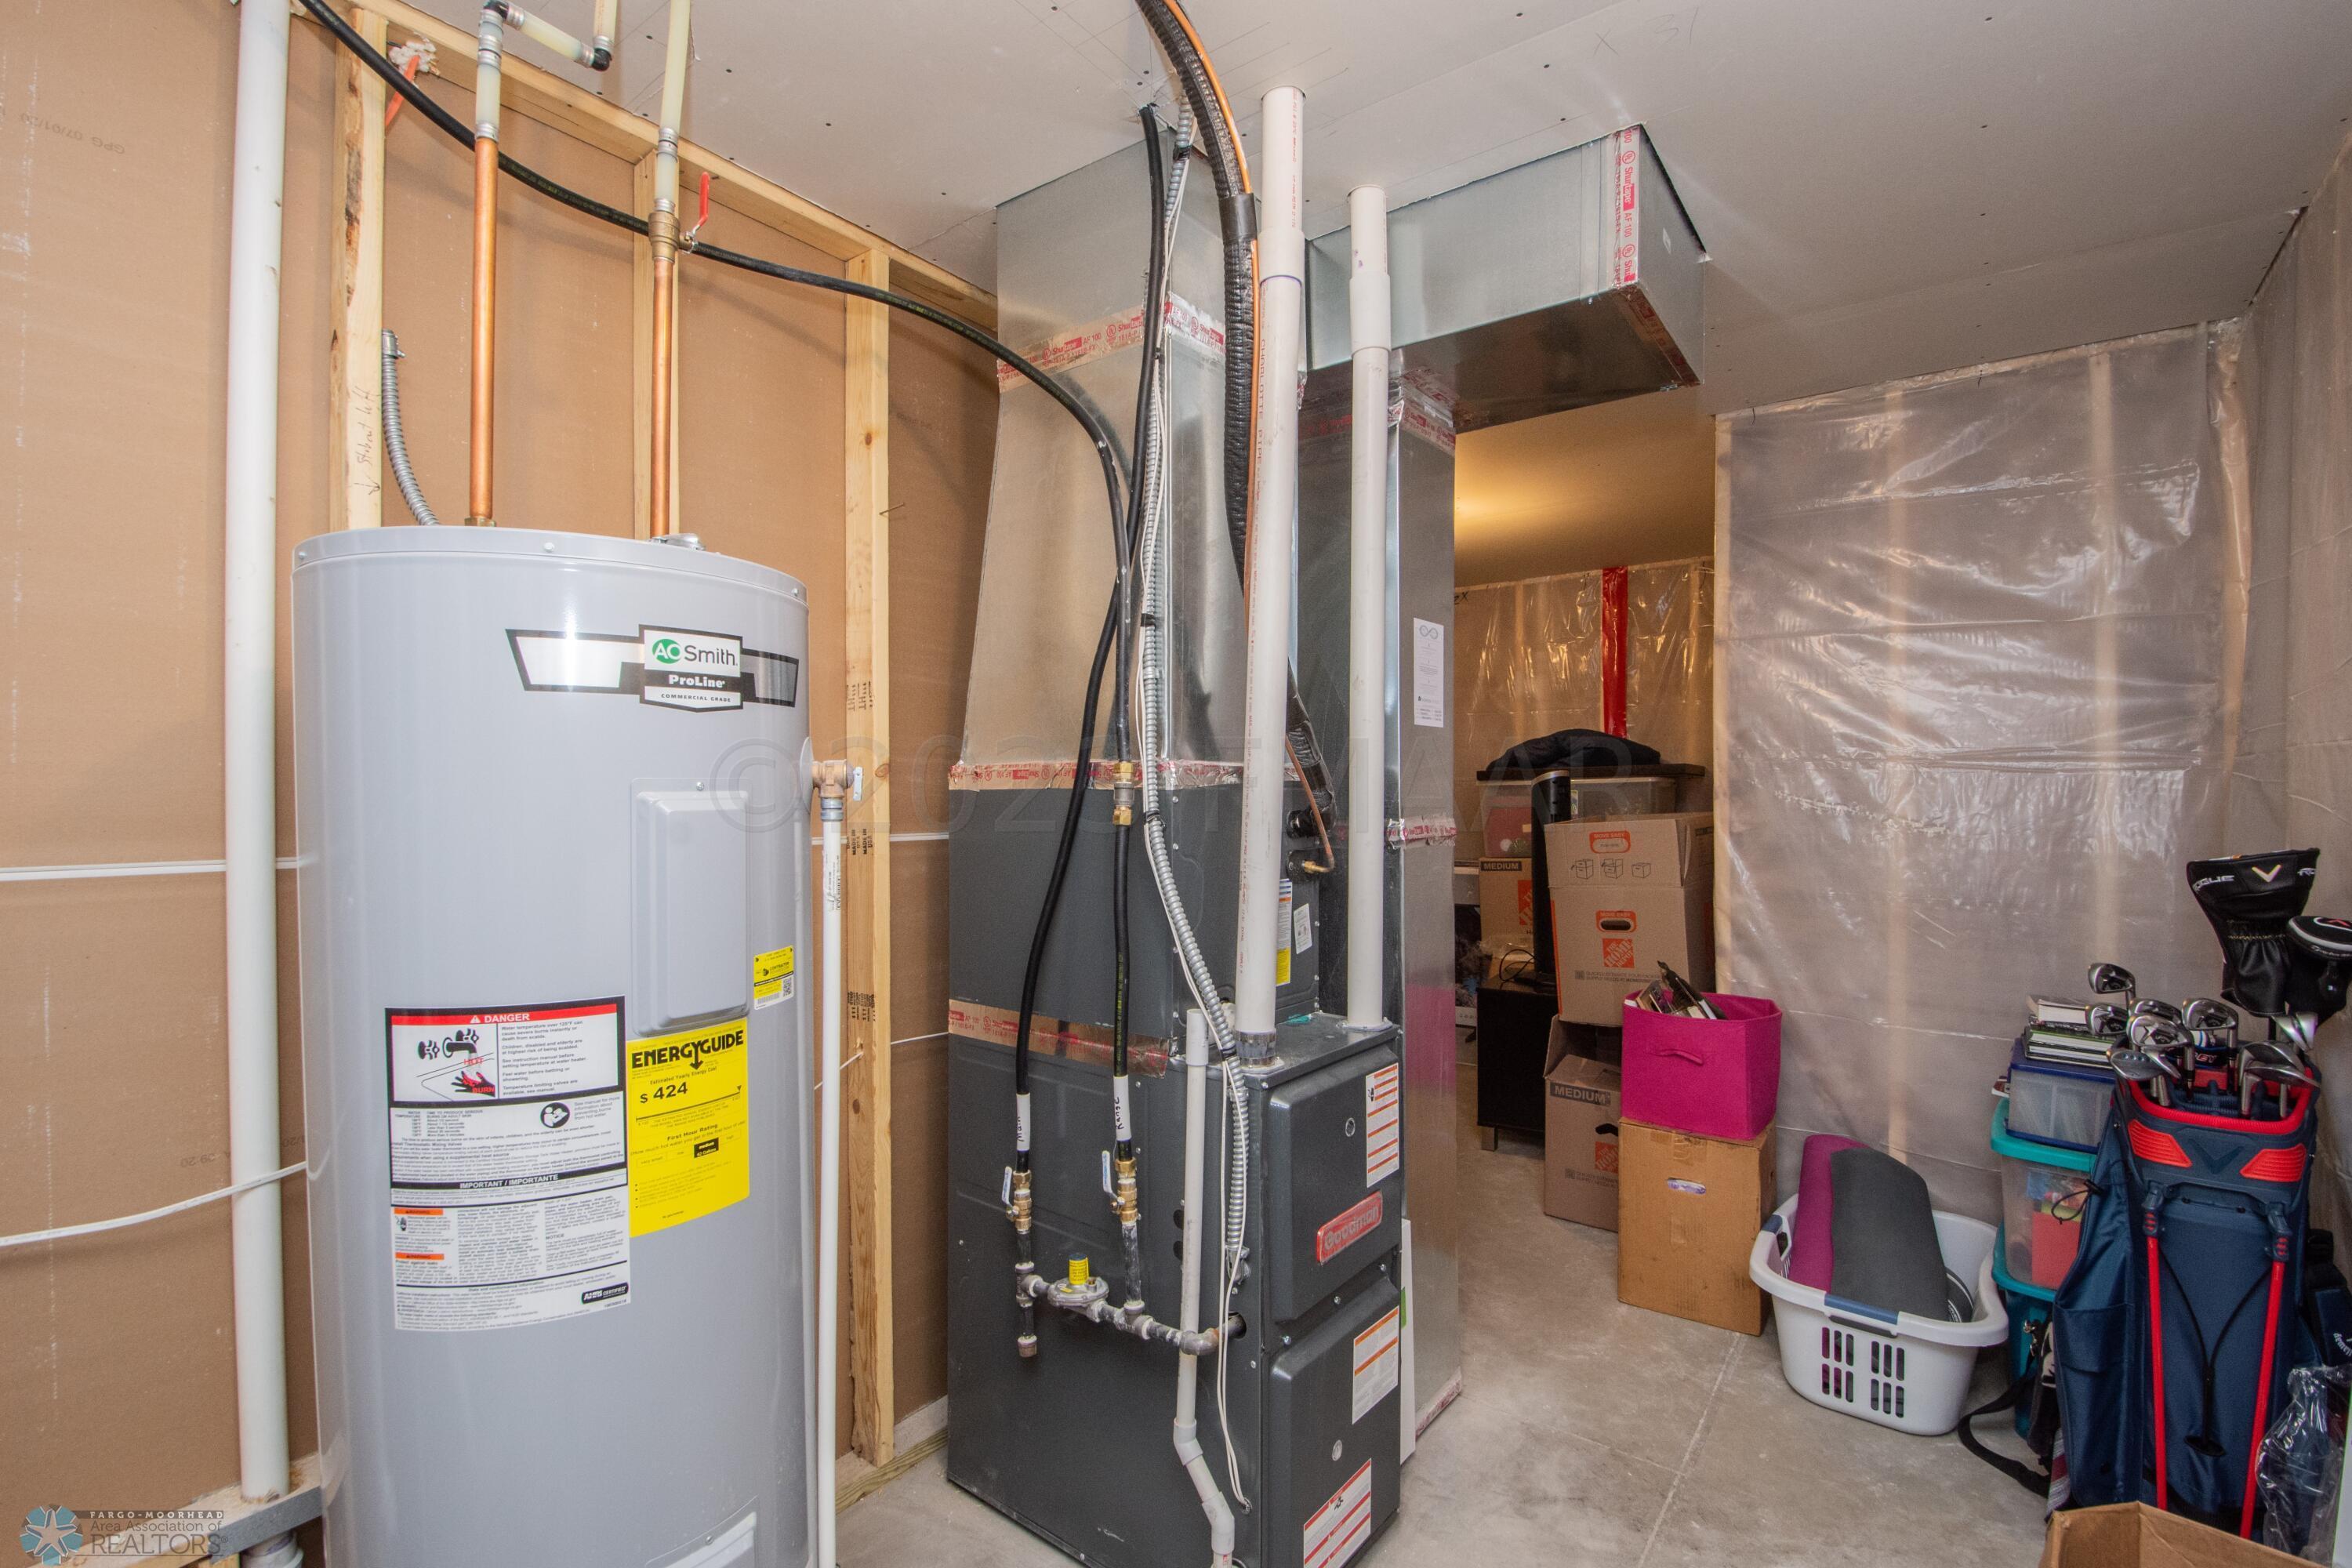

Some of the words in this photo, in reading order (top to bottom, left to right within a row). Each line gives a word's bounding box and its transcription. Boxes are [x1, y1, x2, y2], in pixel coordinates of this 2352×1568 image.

[1624, 212, 1632, 222] AF
[1624, 224, 1632, 238] 100
[1258, 338, 1266, 420] CHARLOTTE
[684, 644, 736, 666] Smith
[669, 674, 725, 689] ProLine
[661, 693, 708, 702] COMMERCIAL
[1605, 940, 1632, 967] HOME
[484, 1013, 531, 1024] DANGER
[631, 1029, 744, 1069] ENERGYGUIDE
[650, 1075, 674, 1085] Estimated
[676, 1072, 691, 1080] Yearly
[640, 1093, 648, 1104] $
[653, 1081, 688, 1100] 424
[1555, 1085, 1606, 1104] MEDIUM
[1114, 1097, 1124, 1130] Range
[699, 1123, 718, 1132] Rating
[459, 1179, 503, 1189] IMPORTANT
[508, 1174, 559, 1186] IMPORTANTE
